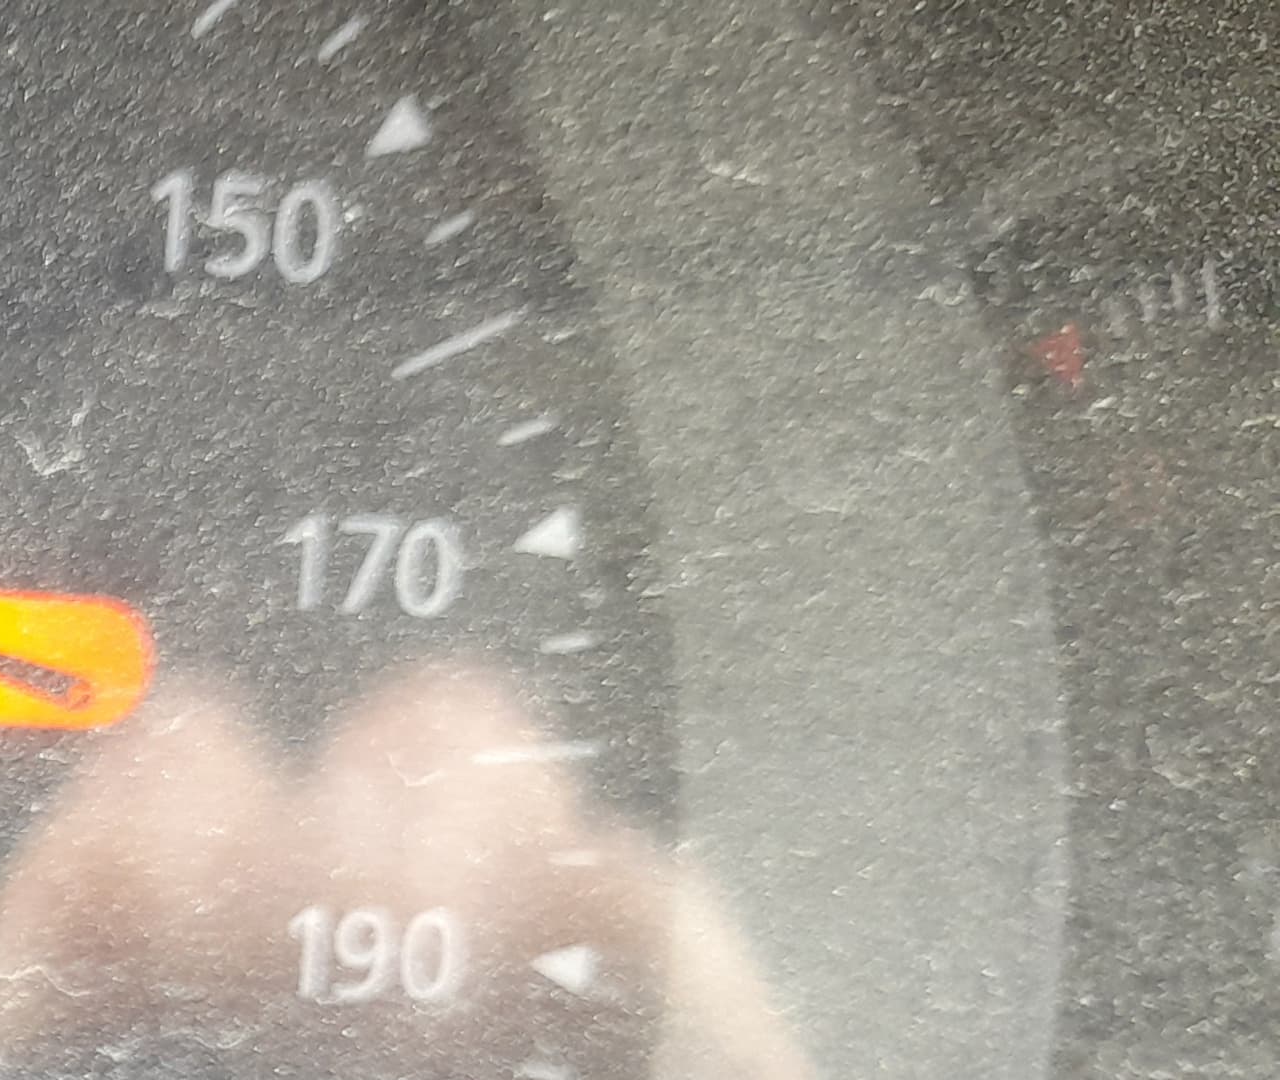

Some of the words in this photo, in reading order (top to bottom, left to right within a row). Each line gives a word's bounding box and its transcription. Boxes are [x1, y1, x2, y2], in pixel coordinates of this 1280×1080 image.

[151, 167, 341, 284] 150
[278, 512, 465, 620] 170
[287, 904, 465, 1003] 190
